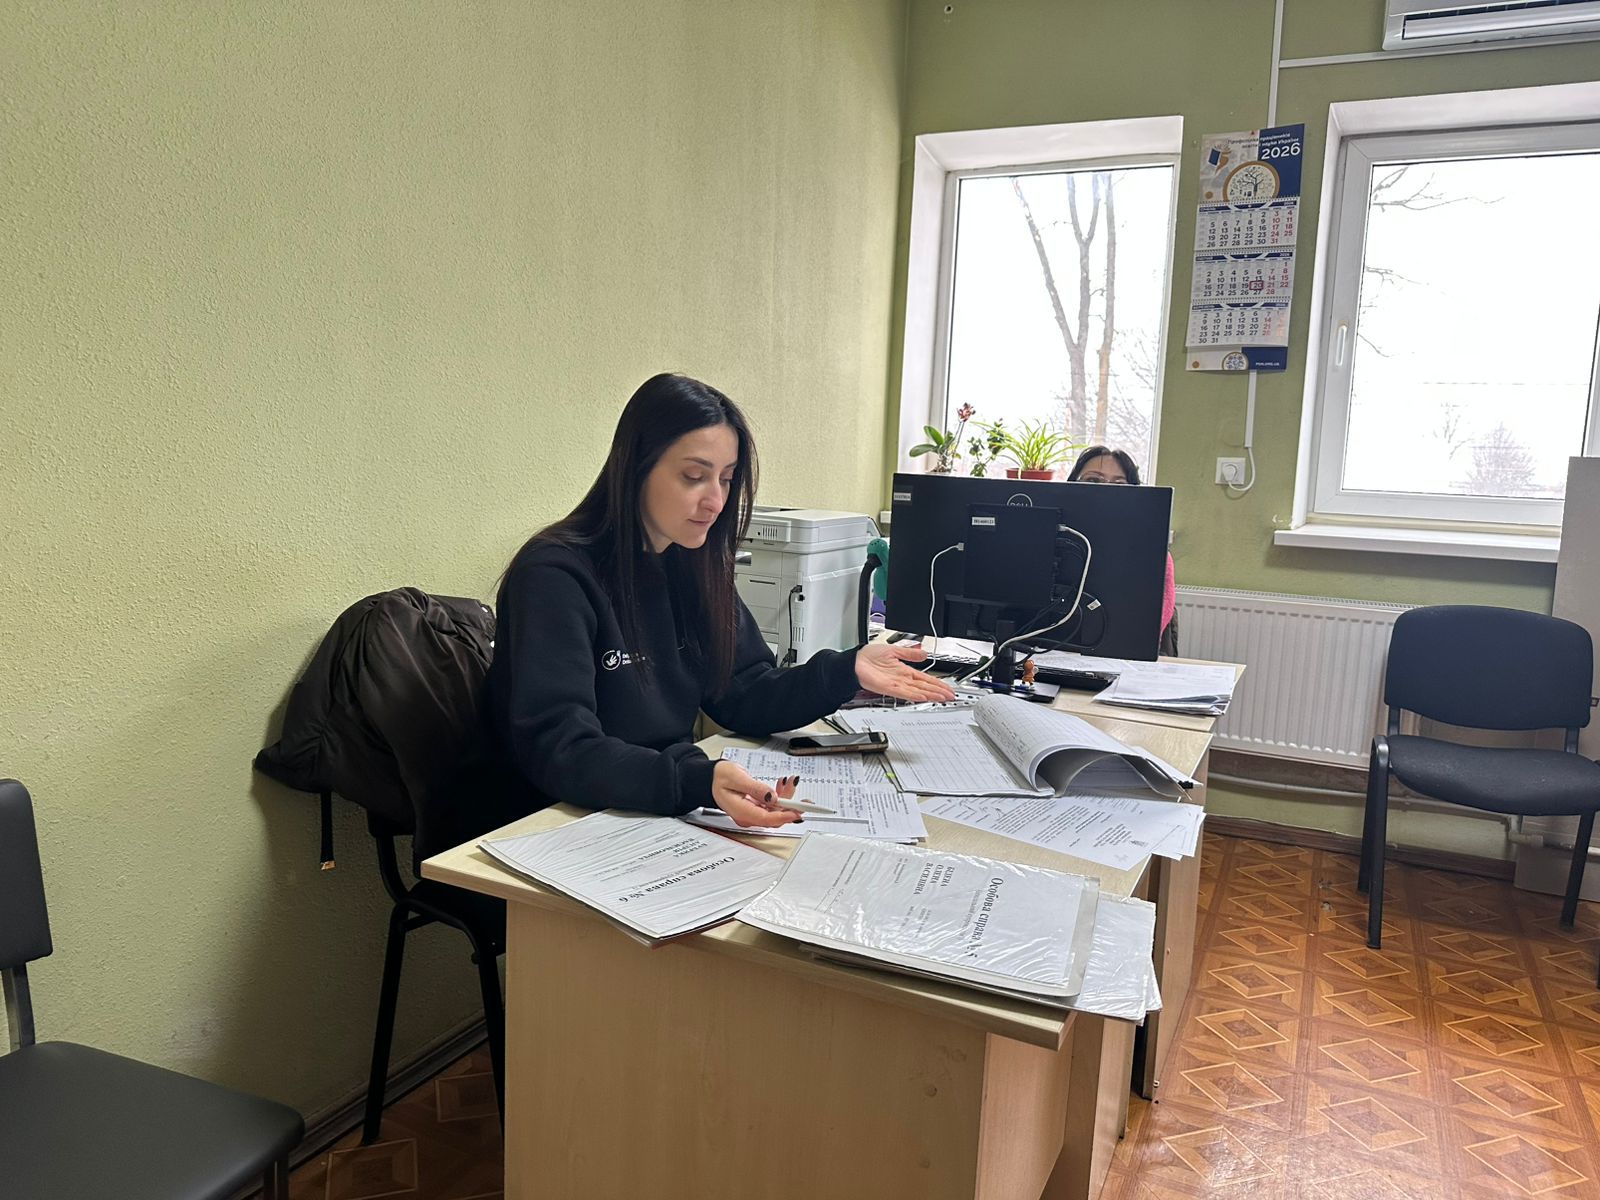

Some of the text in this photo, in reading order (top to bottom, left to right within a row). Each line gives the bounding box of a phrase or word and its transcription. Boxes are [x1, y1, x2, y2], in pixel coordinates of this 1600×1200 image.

[1261, 142, 1300, 160] 2026
[687, 856, 735, 877] Особова
[646, 875, 686, 892] справа
[982, 878, 1004, 912] Особова
[972, 914, 989, 940] справа
